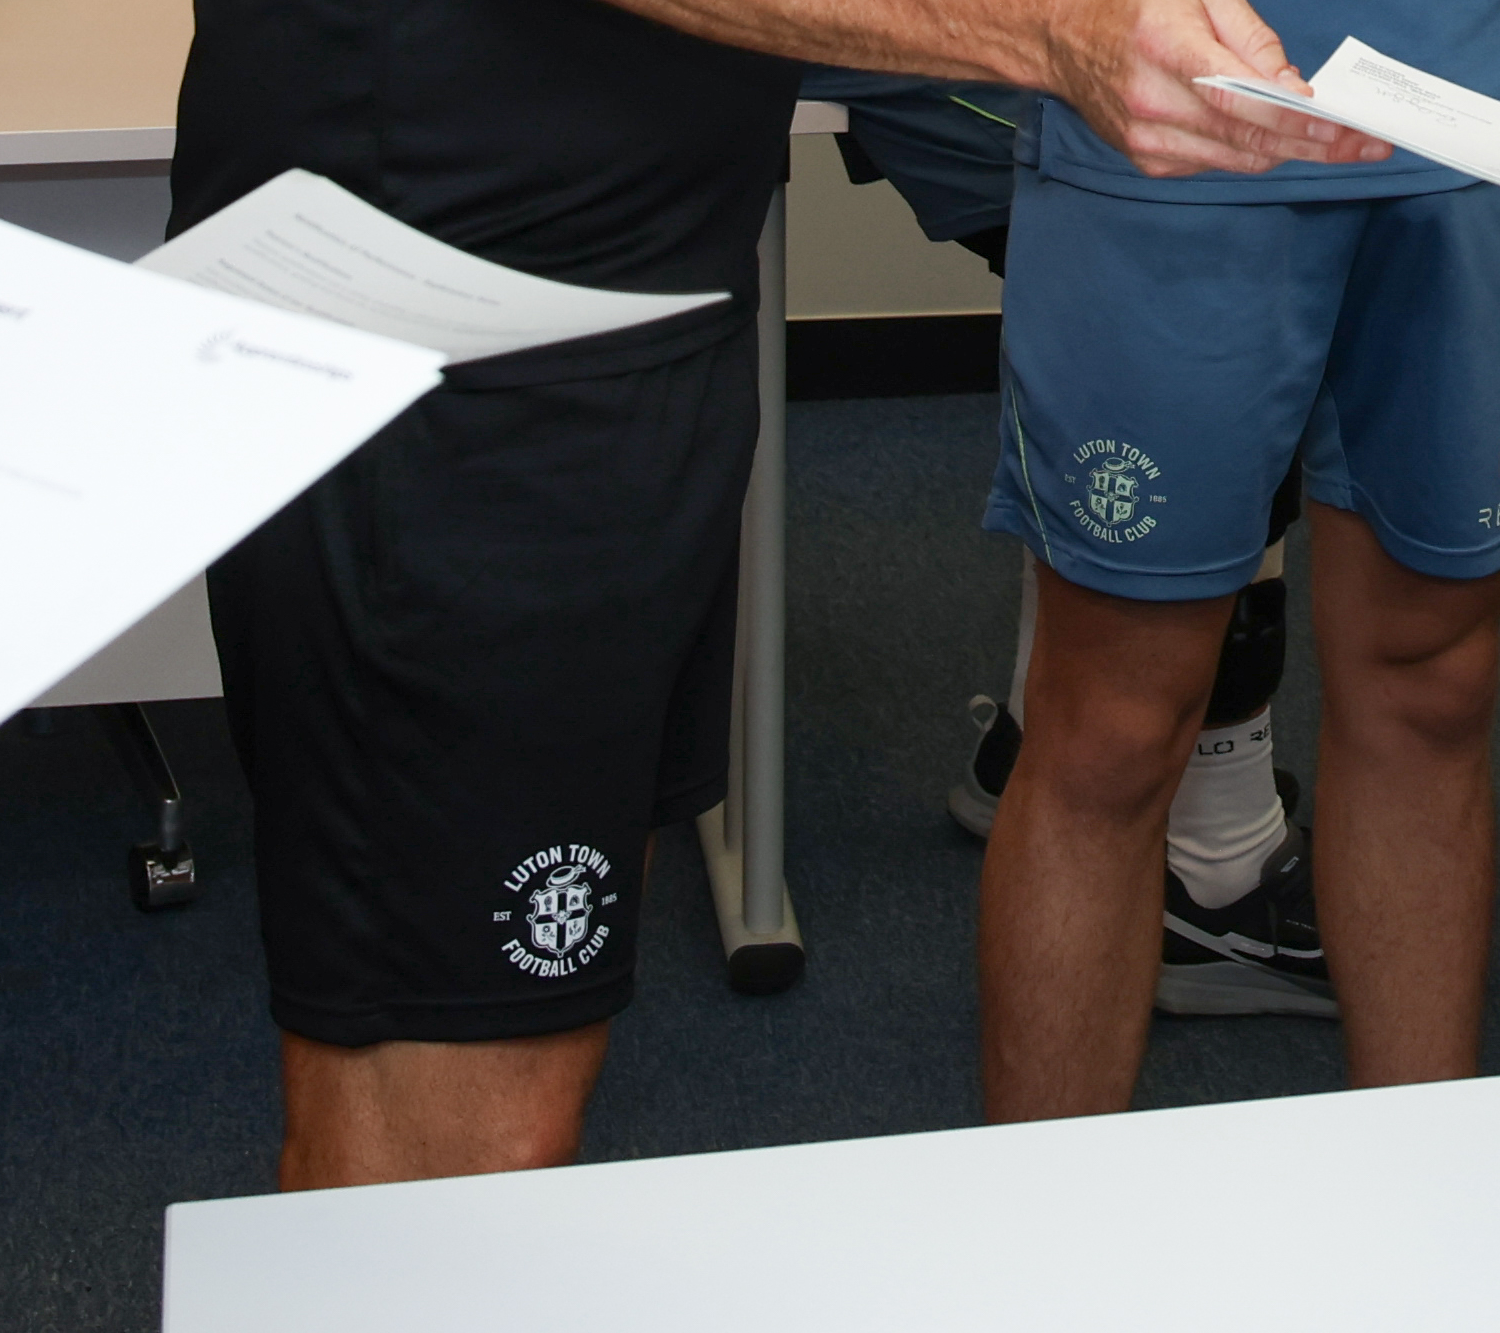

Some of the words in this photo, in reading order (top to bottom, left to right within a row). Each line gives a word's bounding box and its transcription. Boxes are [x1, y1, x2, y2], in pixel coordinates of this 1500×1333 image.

[1073, 439, 1116, 464] LUTON
[1121, 442, 1162, 480] TOWN
[1069, 500, 1123, 543] FOOTBALL
[1124, 515, 1158, 542] CLUB
[503, 845, 563, 893] LUTON
[568, 844, 611, 880] TOWN
[493, 911, 512, 922] EST
[501, 938, 578, 977] FOOTBALL
[578, 924, 610, 965] CLUB
